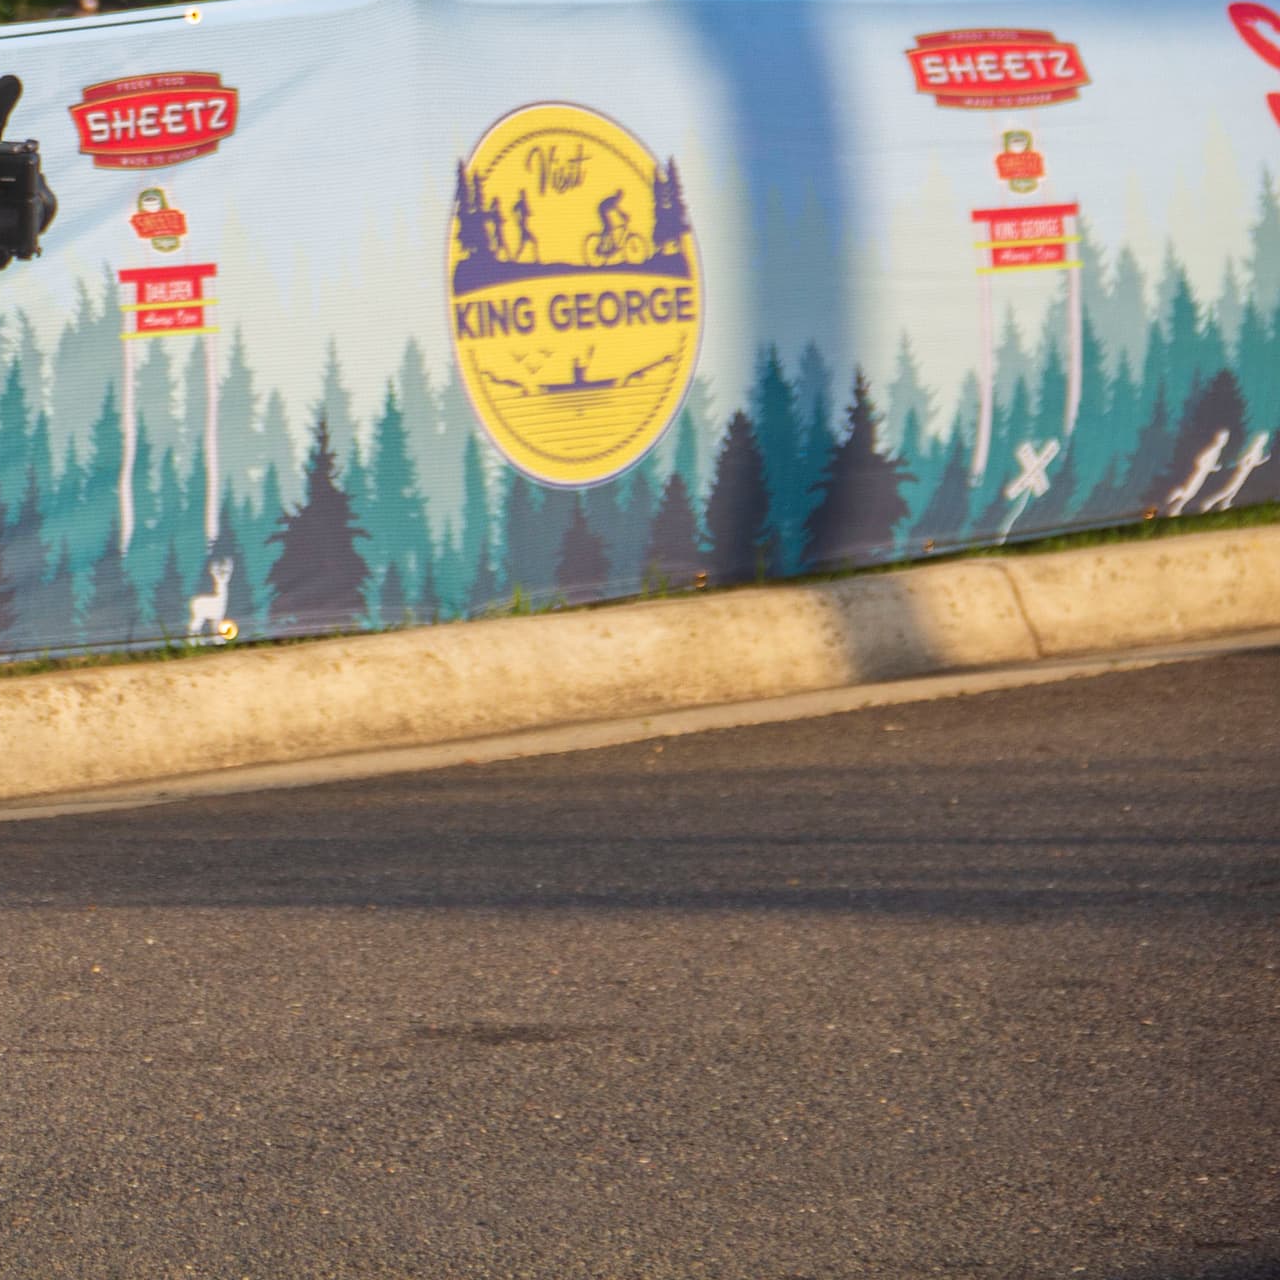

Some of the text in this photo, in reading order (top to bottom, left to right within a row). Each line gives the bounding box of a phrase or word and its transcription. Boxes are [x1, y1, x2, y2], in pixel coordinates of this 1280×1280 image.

[922, 50, 1076, 85] SHEETZ
[86, 97, 228, 143] SHEETZ
[526, 144, 592, 196] Visit
[455, 285, 697, 340] KING GEORGE
